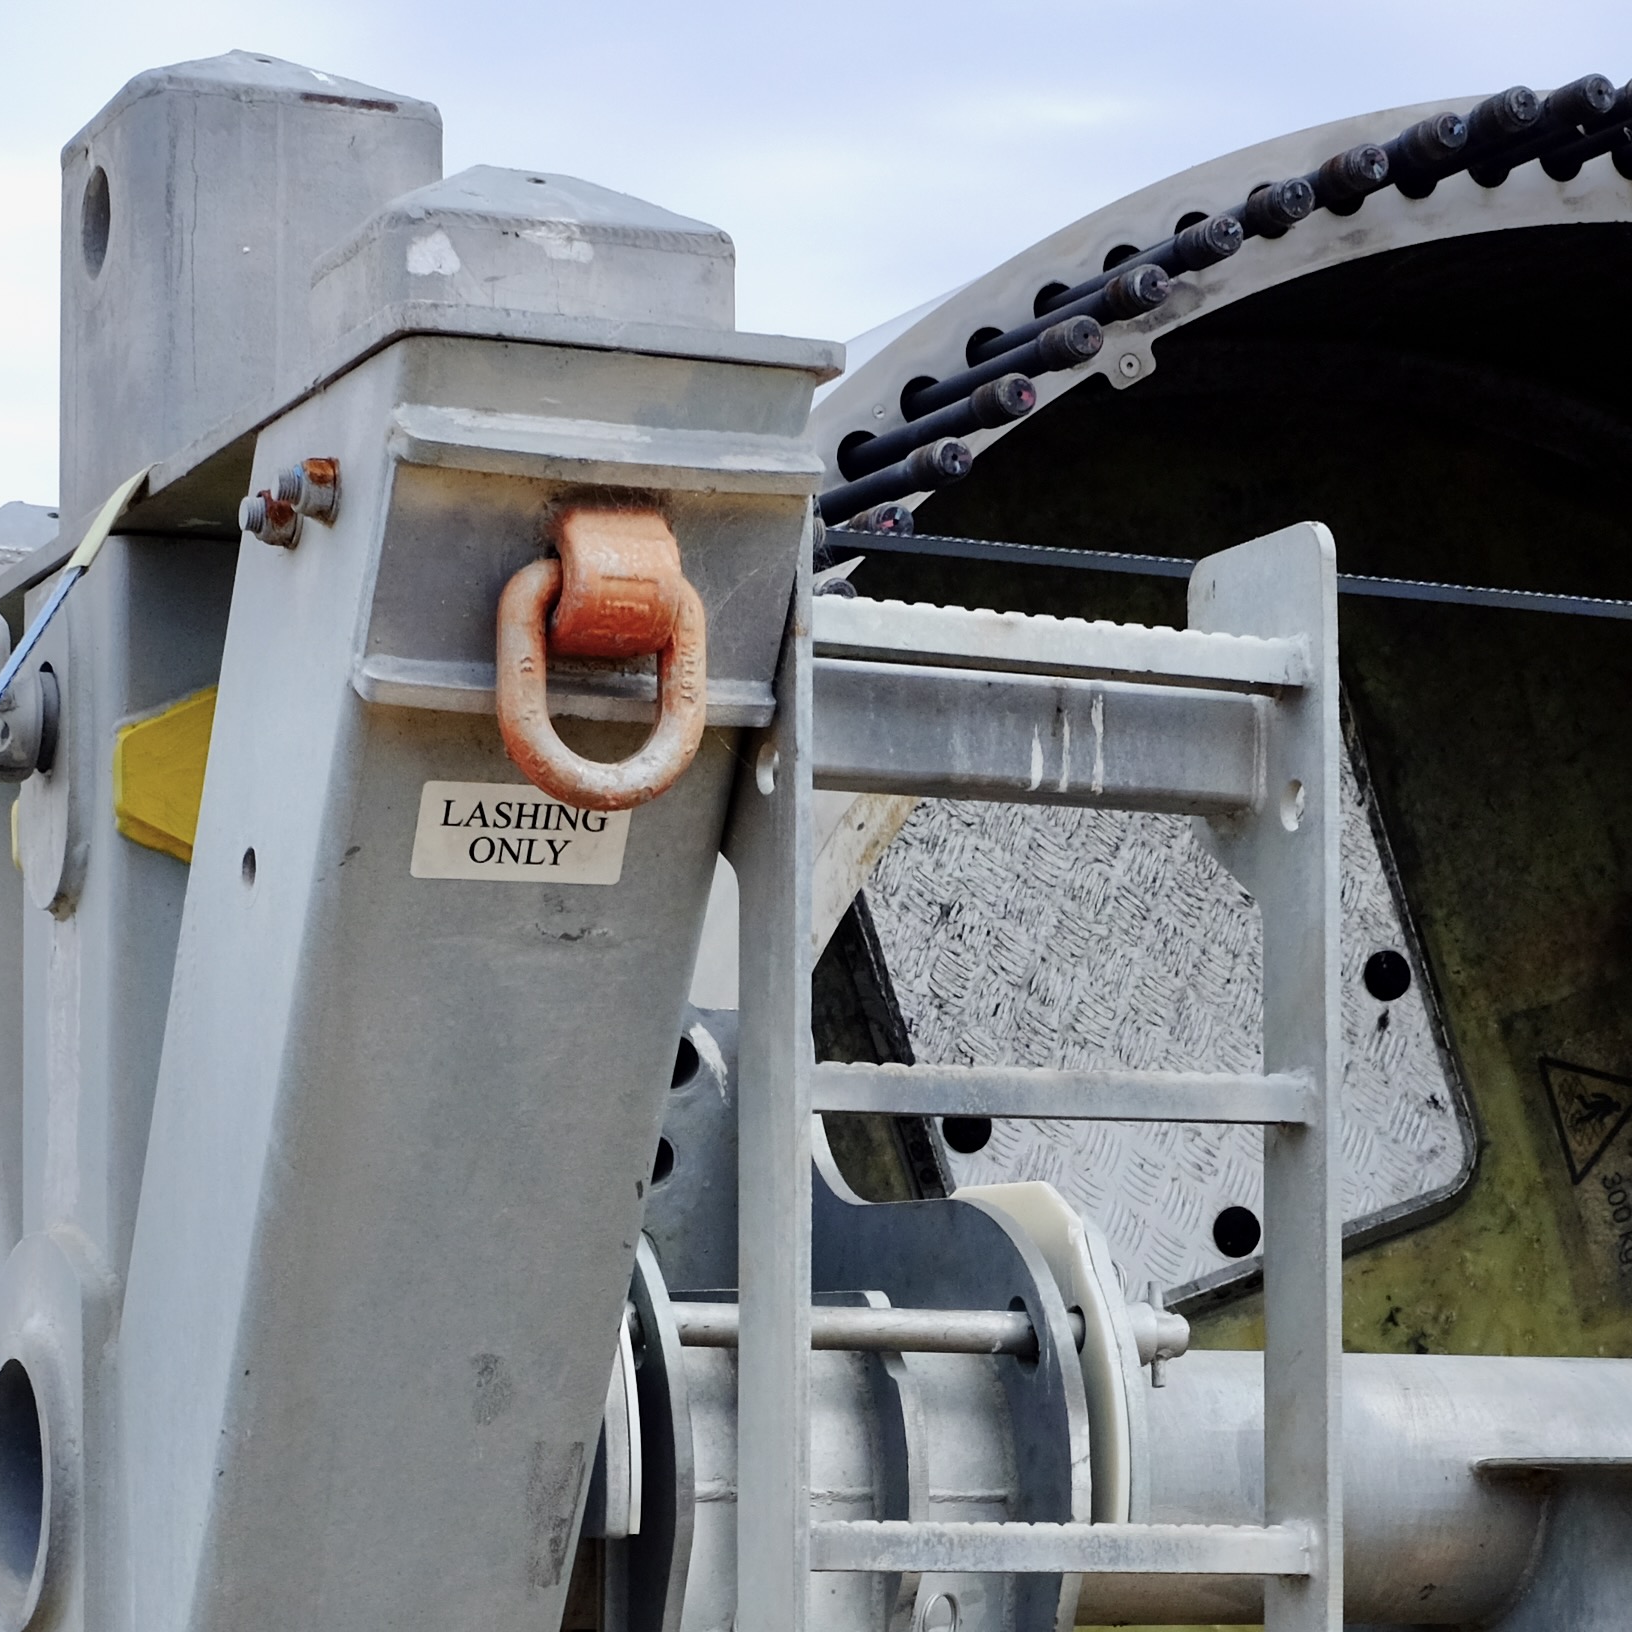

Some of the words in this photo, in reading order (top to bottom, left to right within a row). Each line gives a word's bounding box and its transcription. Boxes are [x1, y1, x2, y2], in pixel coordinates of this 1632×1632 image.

[440, 800, 609, 833] LASHING
[468, 836, 573, 867] ONLY
[1602, 1172, 1632, 1223] 300
